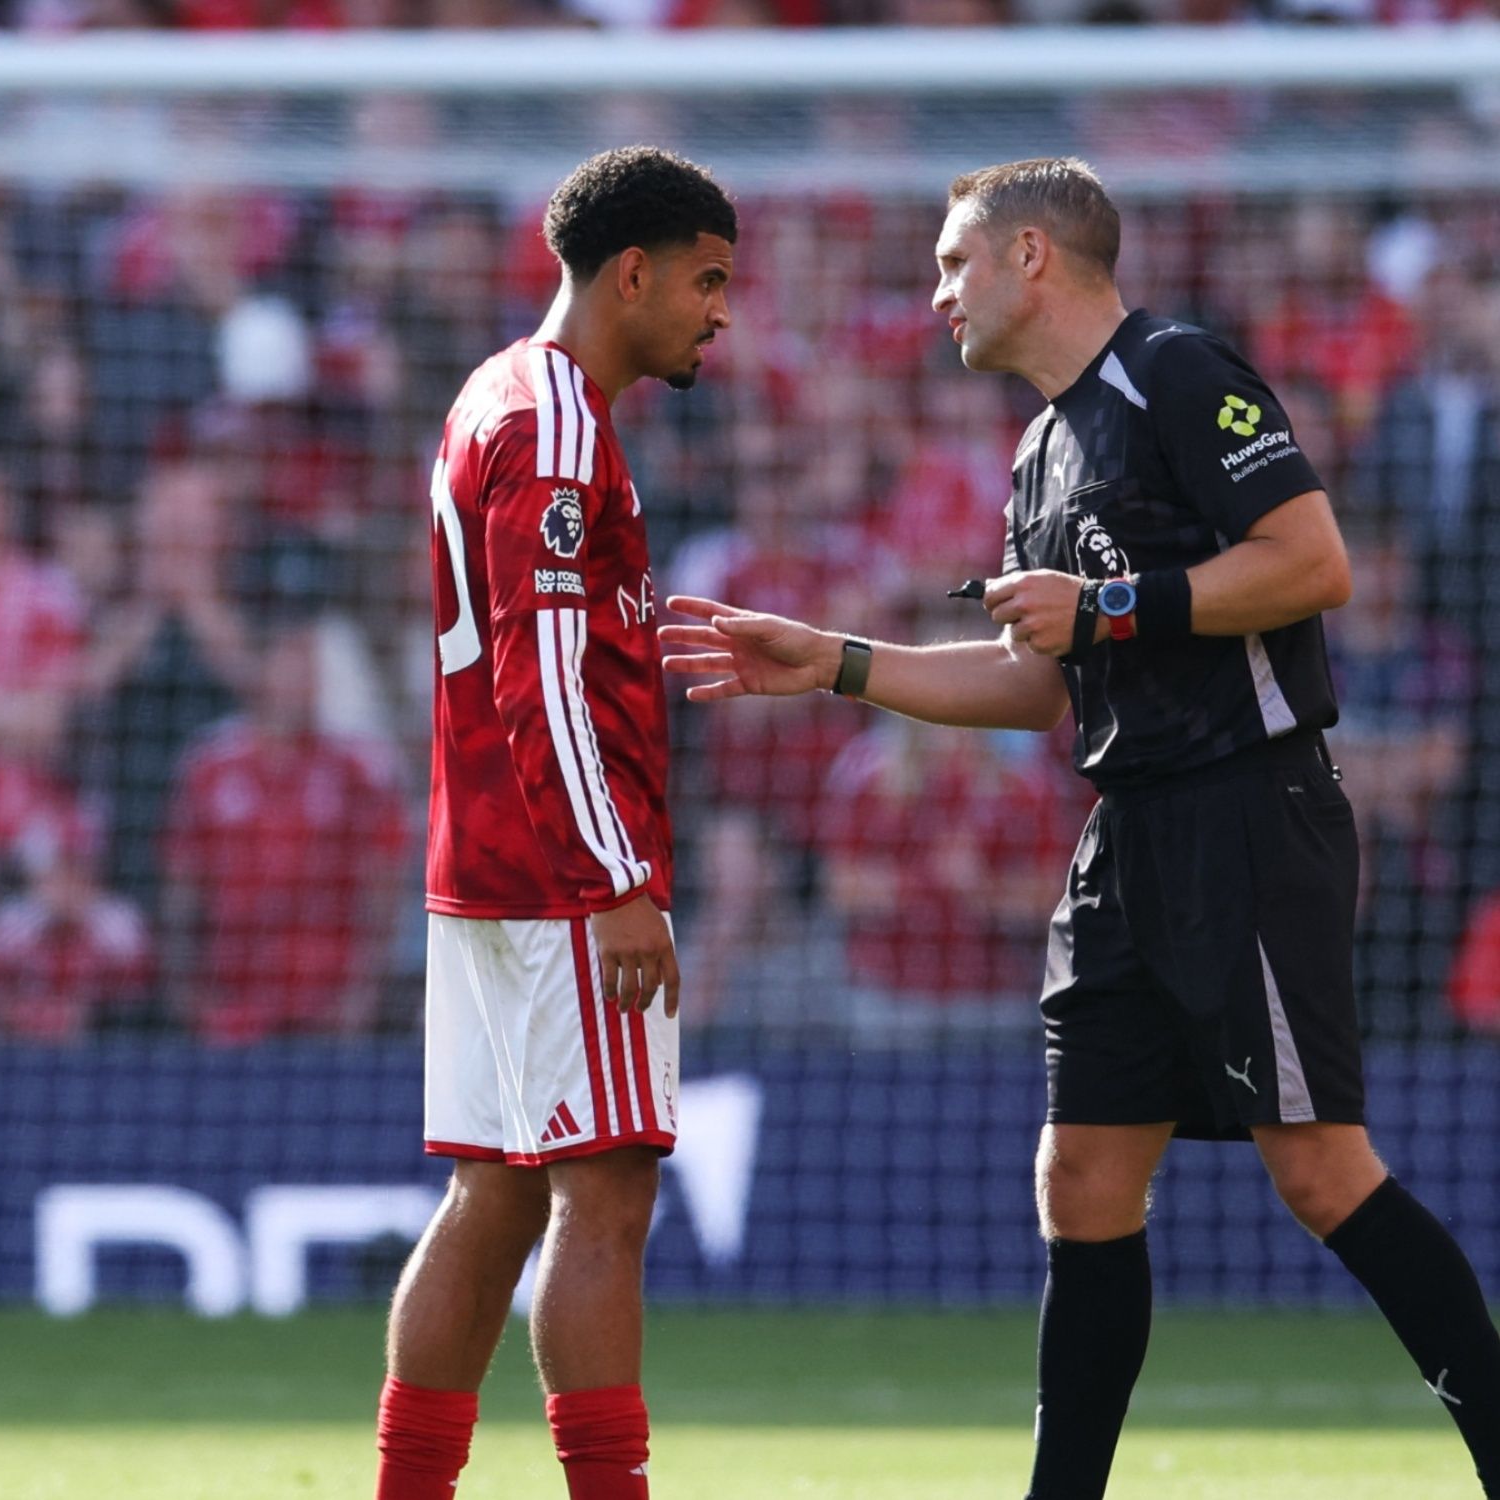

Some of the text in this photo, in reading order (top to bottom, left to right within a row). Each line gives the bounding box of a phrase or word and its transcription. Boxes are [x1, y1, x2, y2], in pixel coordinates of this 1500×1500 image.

[1220, 430, 1290, 470] HuwsGray
[1231, 457, 1269, 482] Building
[534, 569, 555, 582] No
